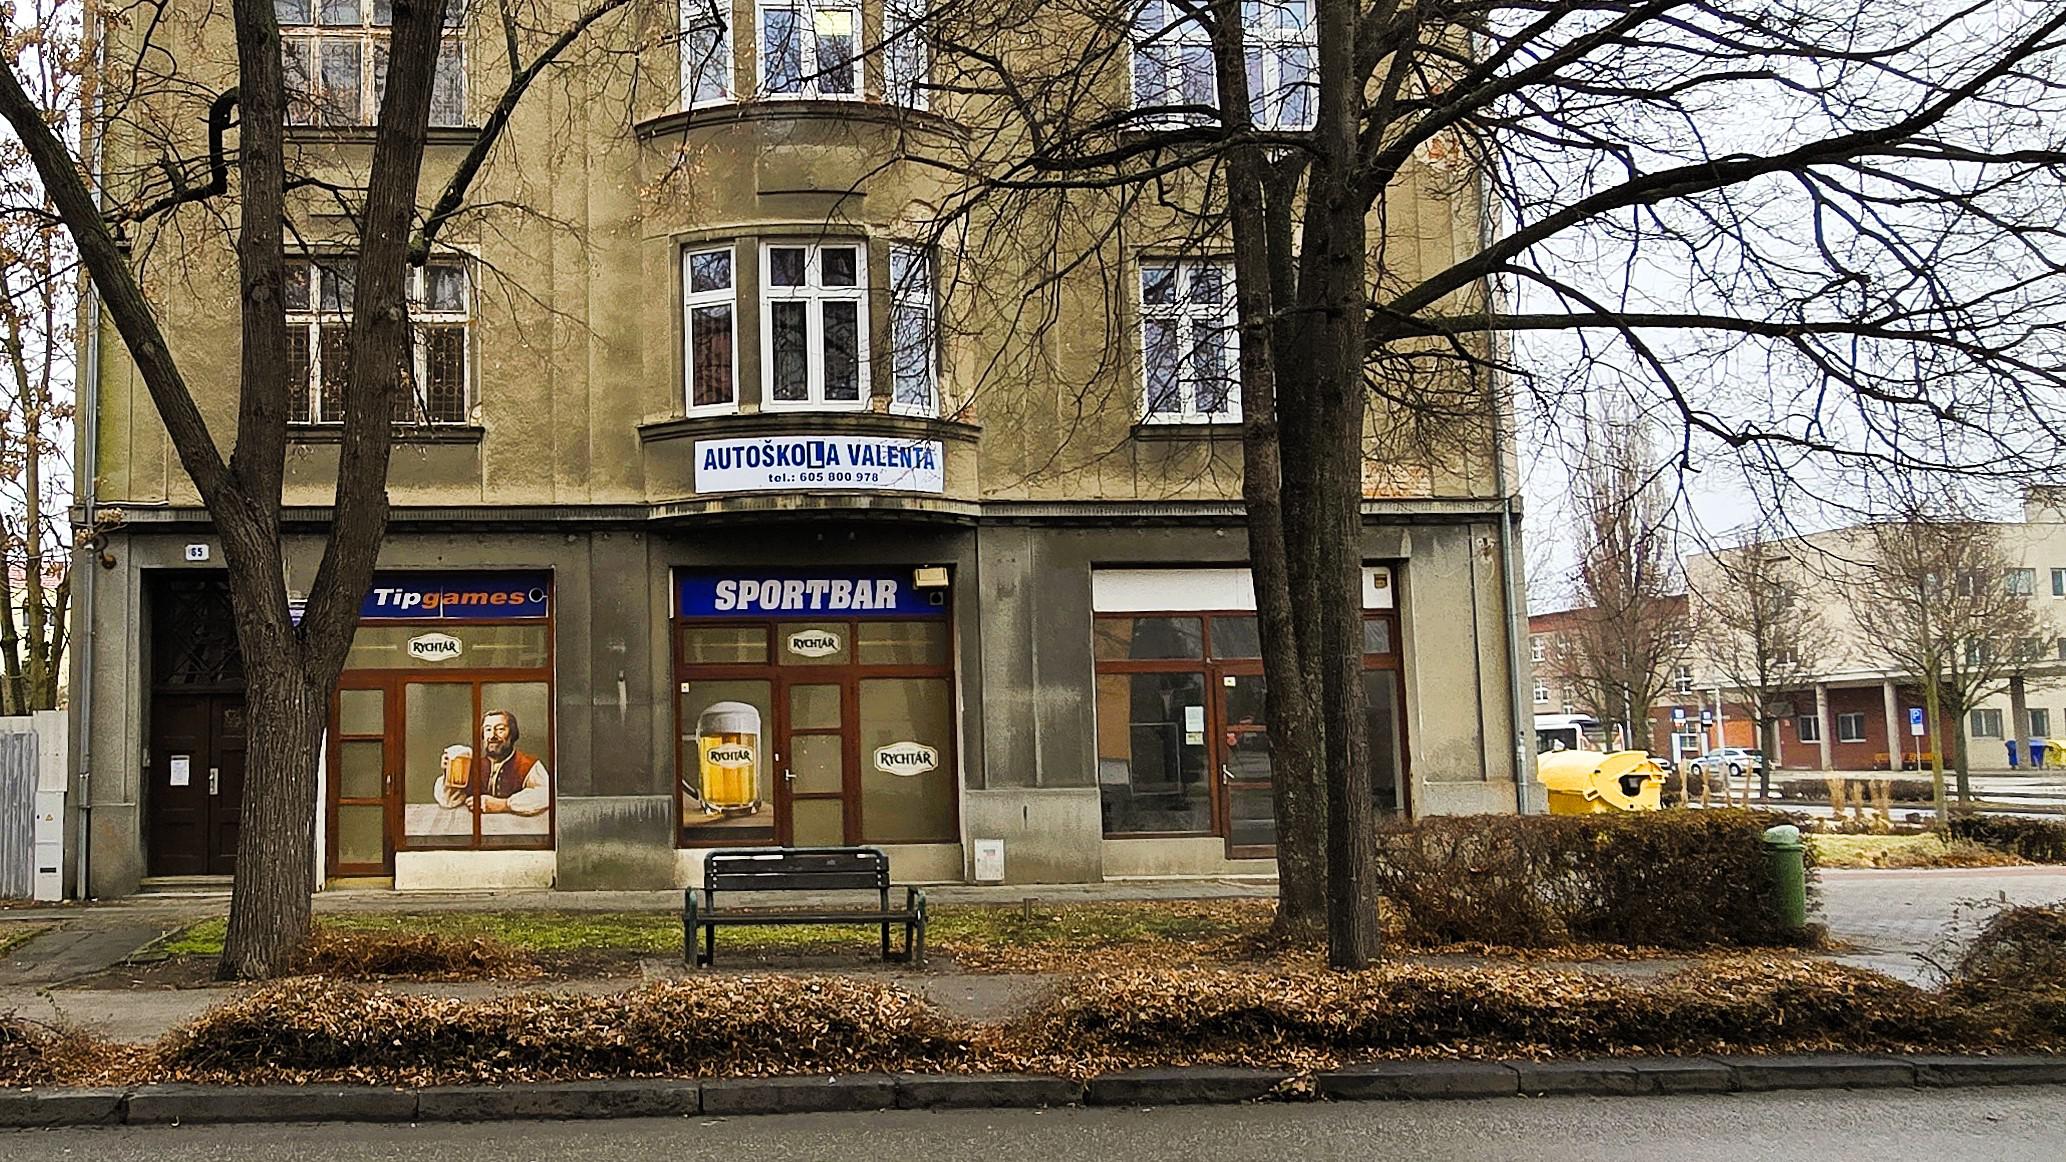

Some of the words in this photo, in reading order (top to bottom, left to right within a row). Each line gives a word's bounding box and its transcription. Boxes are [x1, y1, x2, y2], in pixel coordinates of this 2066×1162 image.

[704, 440, 840, 470] AUTOŠKOLA
[847, 443, 935, 470] VALENTA
[768, 473, 795, 483] tel.:
[799, 472, 824, 482] 605
[828, 472, 851, 482] 800
[856, 472, 879, 482] 978
[191, 547, 203, 557] 65
[373, 588, 526, 610] Tipgames
[714, 579, 898, 611] SPORTBAR
